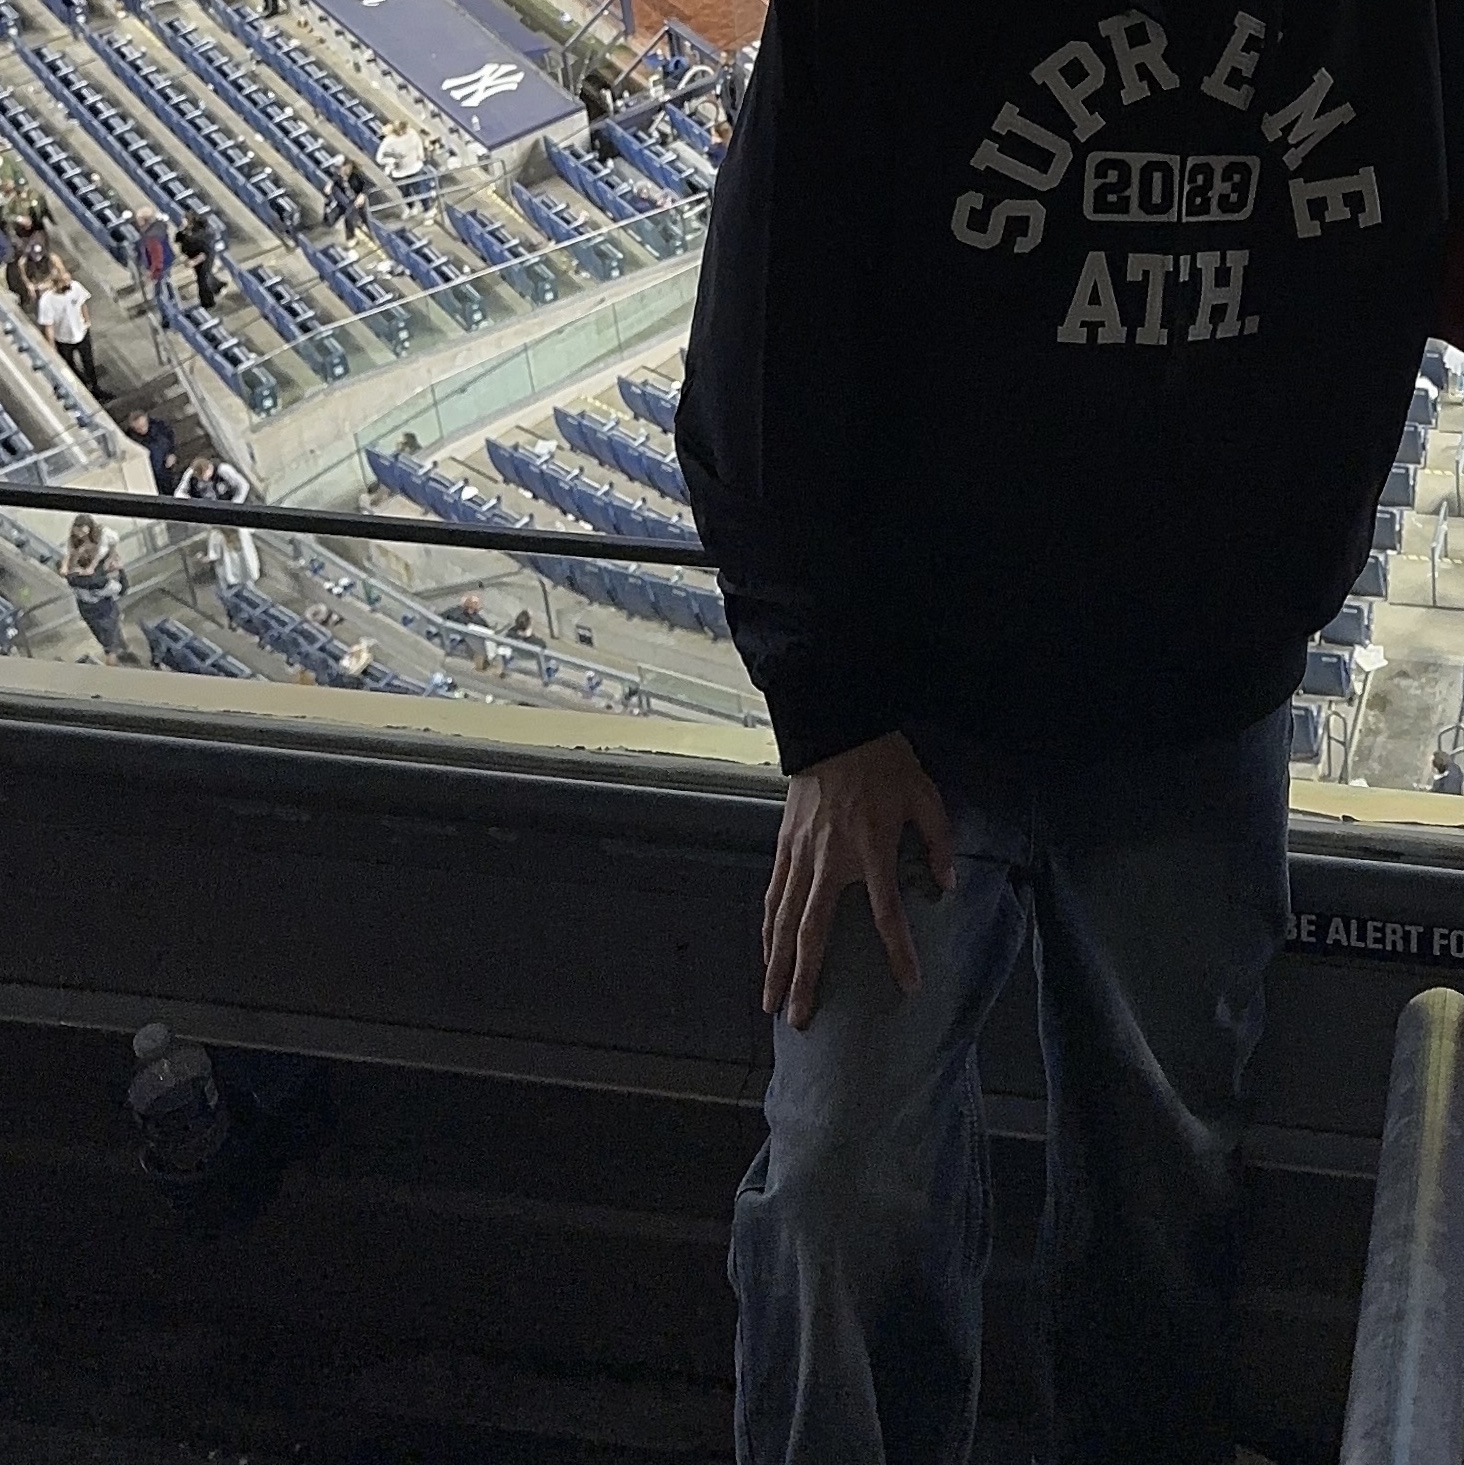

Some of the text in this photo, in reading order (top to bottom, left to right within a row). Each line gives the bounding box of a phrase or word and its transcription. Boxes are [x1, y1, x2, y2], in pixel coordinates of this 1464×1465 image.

[950, 9, 1383, 254] SUPREME
[1093, 157, 1255, 217] 2023
[1325, 916, 1425, 954] ALERT
